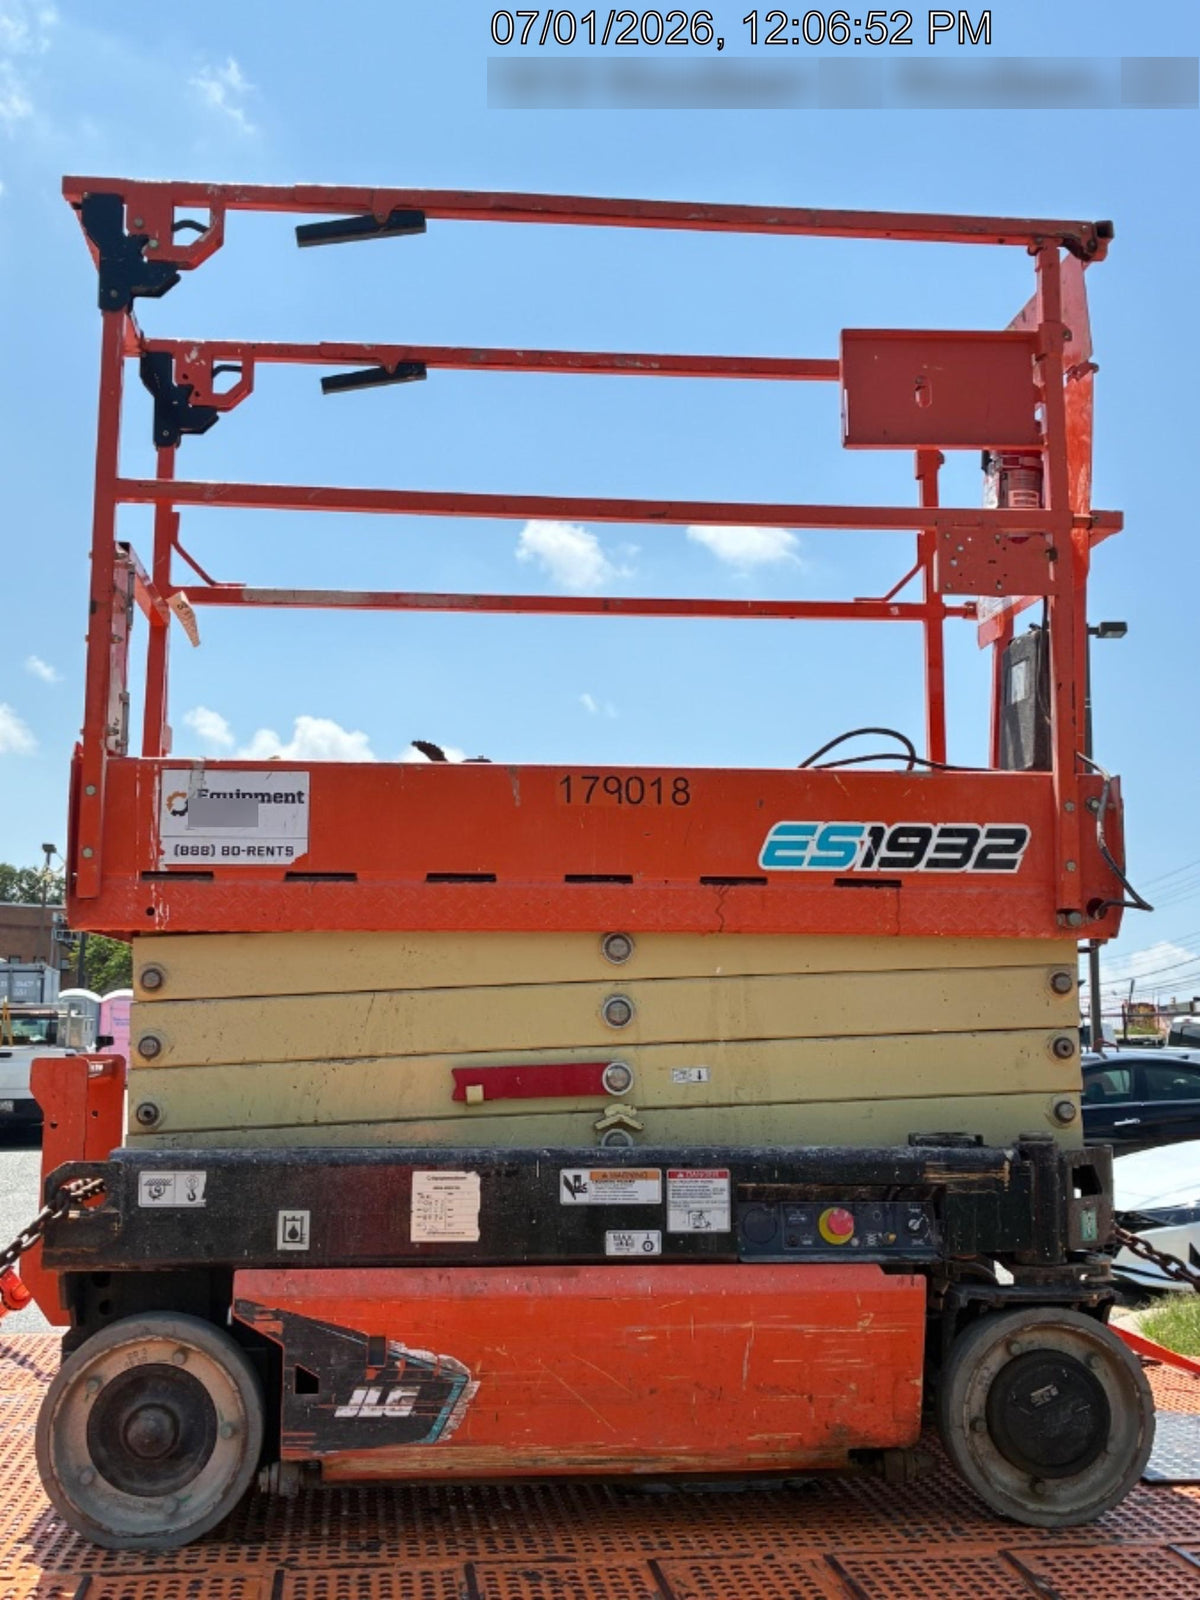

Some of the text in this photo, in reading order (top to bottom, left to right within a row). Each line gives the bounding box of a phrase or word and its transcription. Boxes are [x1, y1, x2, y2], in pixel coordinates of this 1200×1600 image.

[559, 775, 691, 806] 179018
[174, 844, 216, 857] (888)
[758, 821, 1032, 874] ES1932
[334, 1386, 420, 1418] JLG
